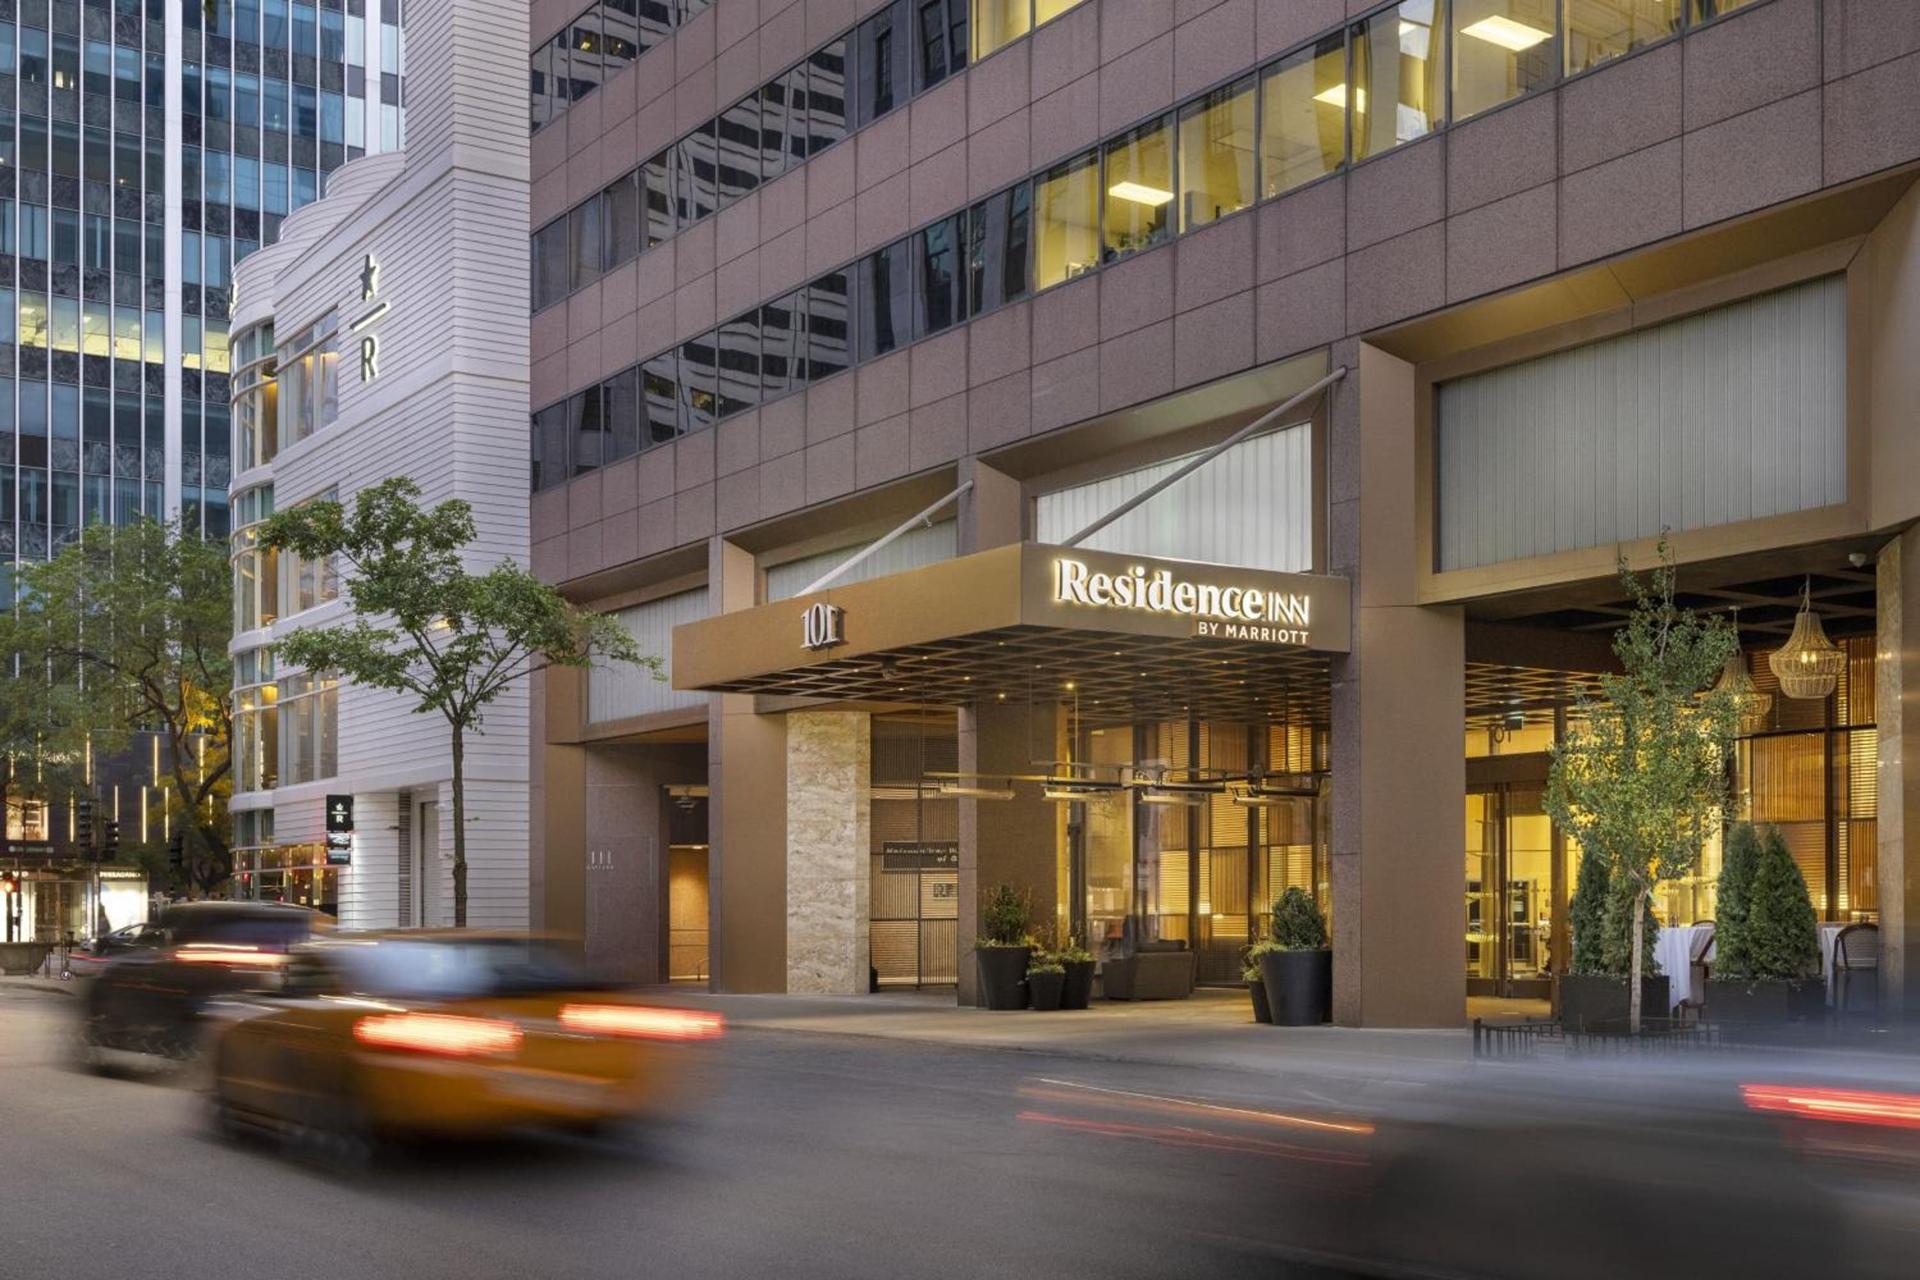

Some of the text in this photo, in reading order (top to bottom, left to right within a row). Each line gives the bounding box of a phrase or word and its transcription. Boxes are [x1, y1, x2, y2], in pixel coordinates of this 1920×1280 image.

[361, 336, 378, 381] R
[1055, 558, 1264, 620] Residence
[800, 603, 841, 648] 101
[1198, 621, 1309, 645] BY MARRIOTT
